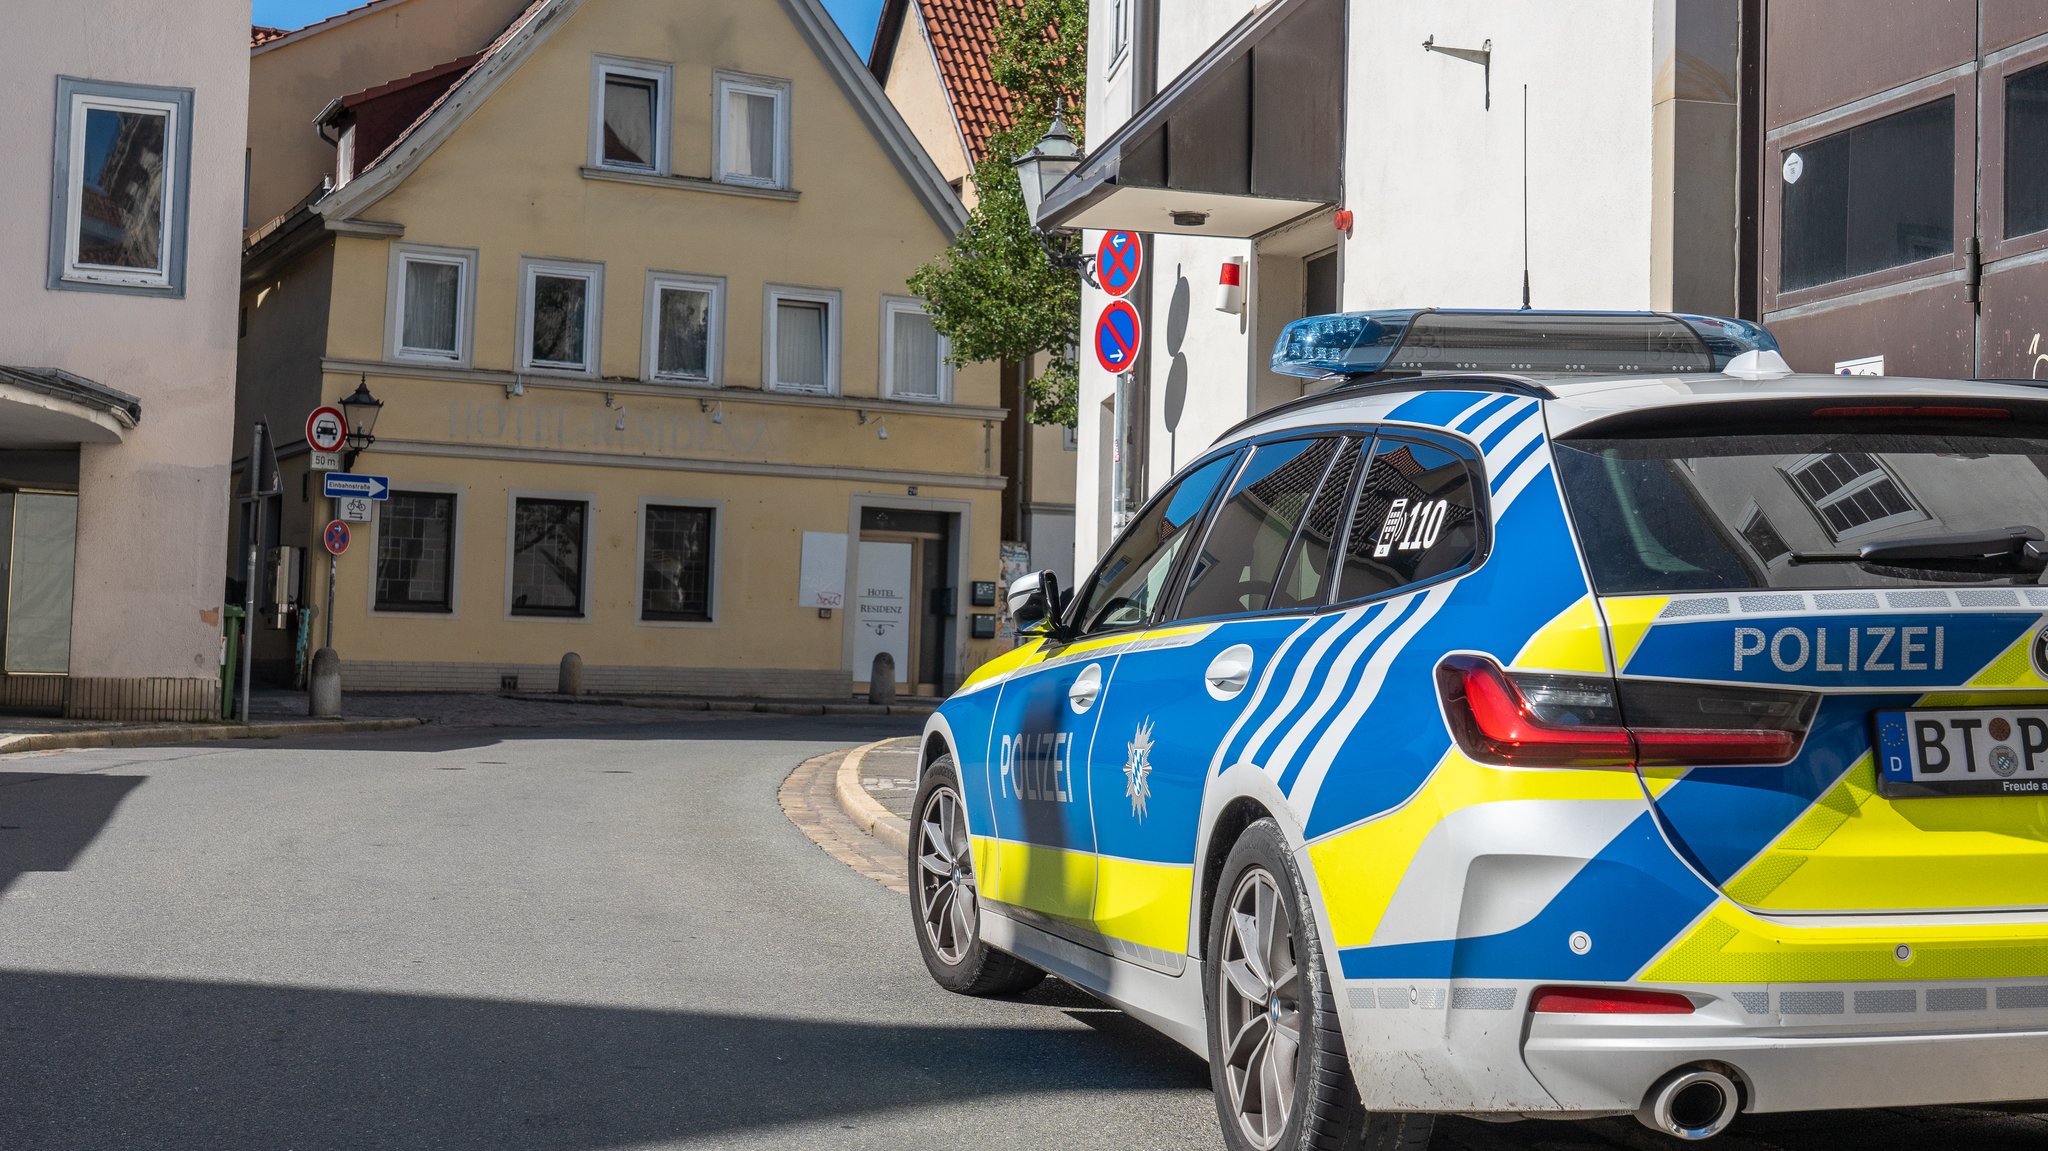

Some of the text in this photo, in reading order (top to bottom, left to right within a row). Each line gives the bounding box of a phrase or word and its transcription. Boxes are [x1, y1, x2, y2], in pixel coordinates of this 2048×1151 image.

[315, 455, 326, 465] 50
[328, 481, 370, 490] Einbahnstraße
[1398, 499, 1447, 550] 110
[867, 588, 895, 597] HOTEL
[860, 604, 903, 614] RESIDENZ
[1733, 626, 1945, 672] POLIZEI
[1914, 718, 1982, 774] BT
[1000, 732, 1073, 803] POLIZEI
[1890, 756, 1903, 772] D
[2002, 781, 2040, 791] Freude
